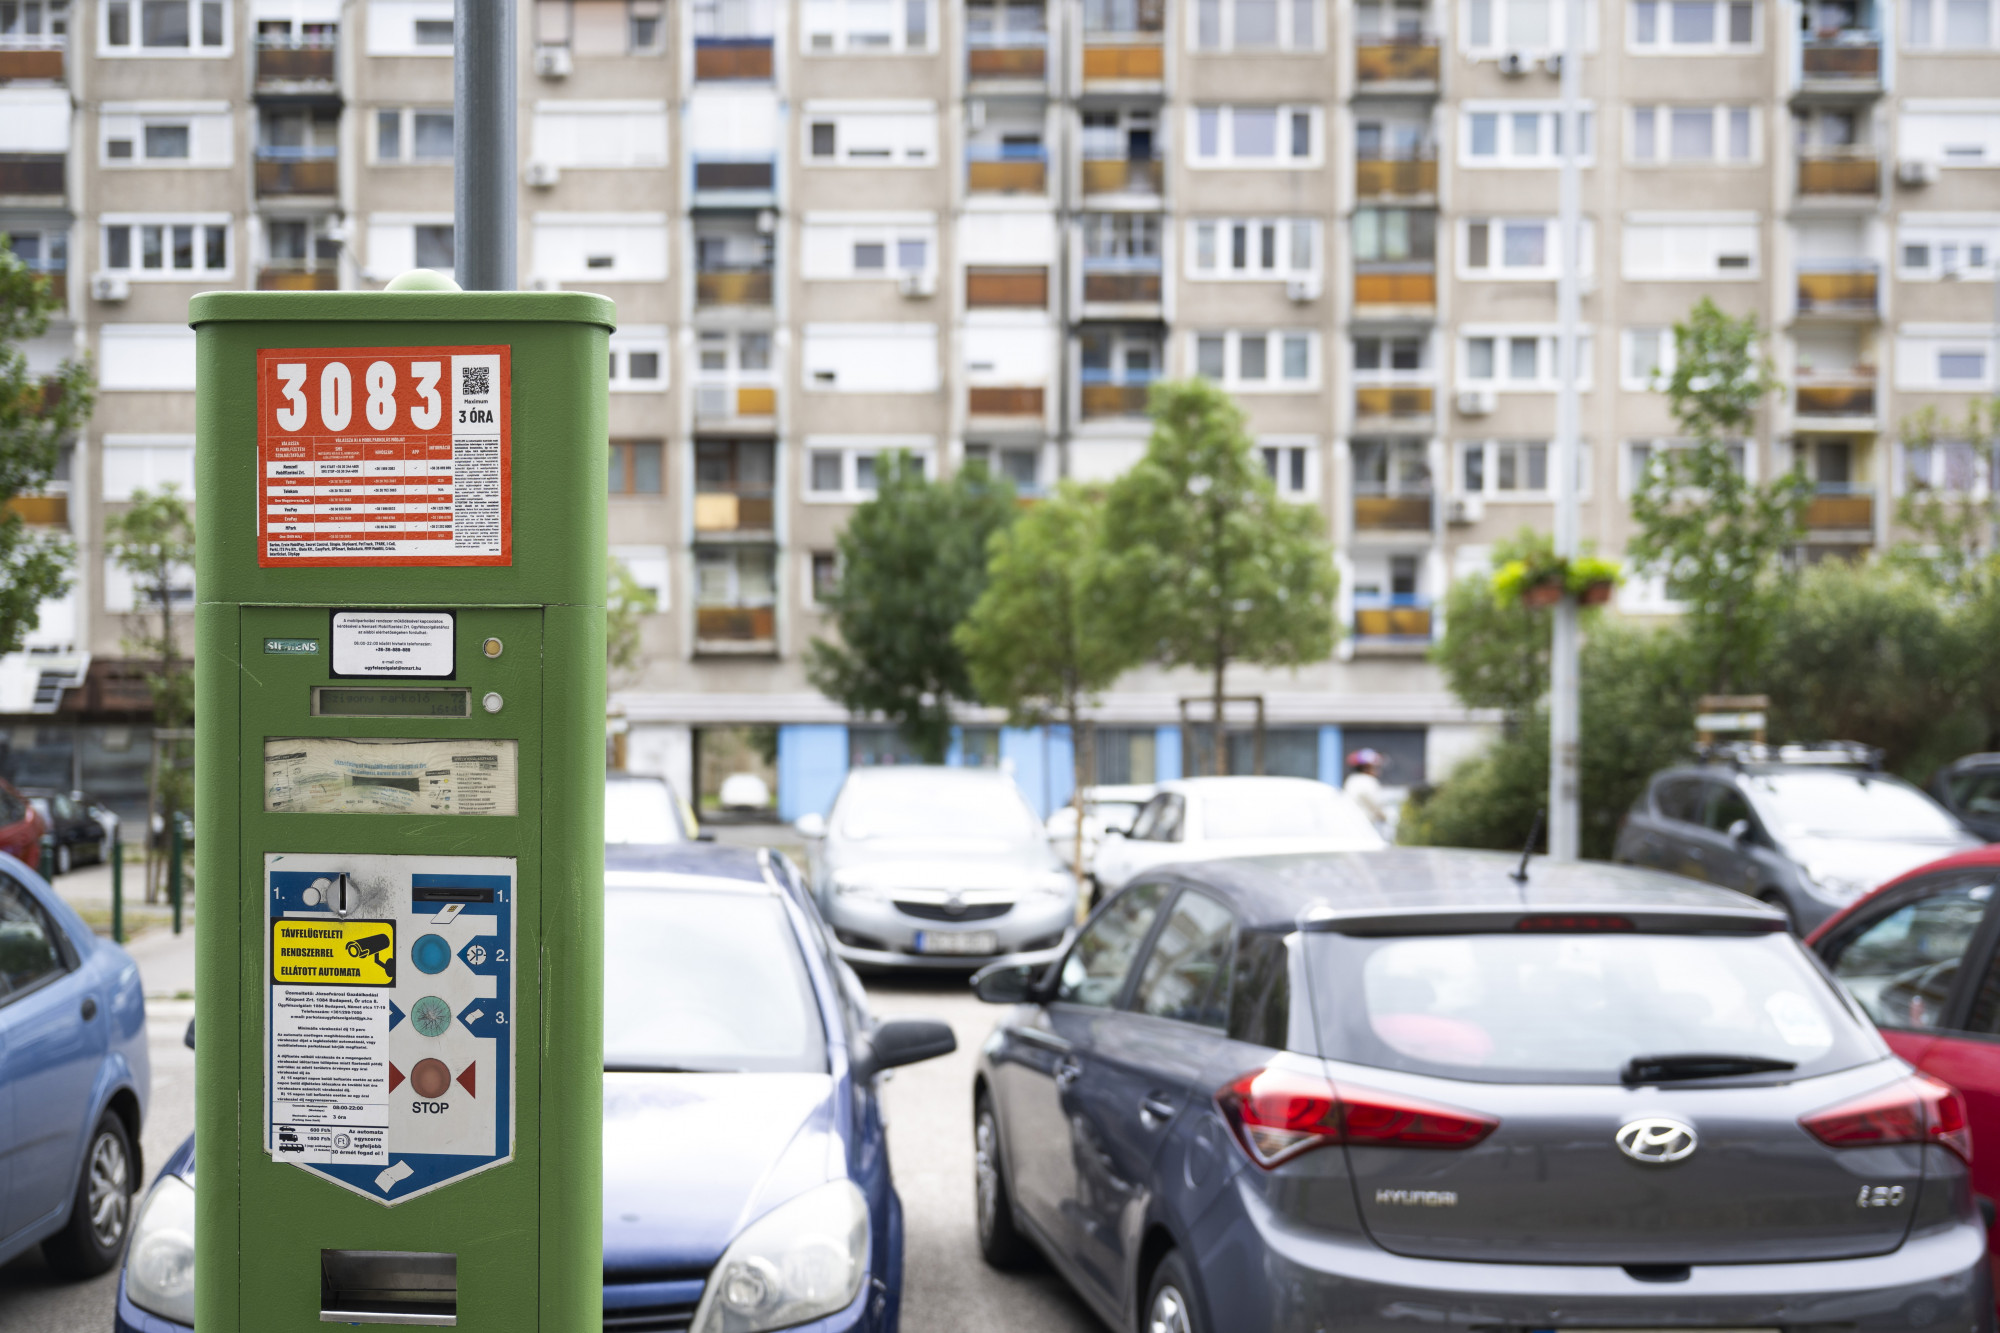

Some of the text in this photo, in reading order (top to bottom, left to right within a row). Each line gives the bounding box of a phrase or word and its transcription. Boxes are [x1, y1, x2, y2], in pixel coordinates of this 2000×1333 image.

[277, 361, 442, 432] 3083
[459, 407, 494, 423] 3 ÓRA
[273, 887, 286, 900] 1.
[496, 890, 509, 903] 1.
[281, 928, 343, 939] TÁVFELÜGYELETI
[281, 948, 334, 958] RENDSZERREL
[496, 949, 509, 962] 2.
[281, 965, 361, 976] ELLÁTOTT AUTOMATA
[496, 1012, 509, 1024] 3.
[412, 1102, 449, 1114] STOP
